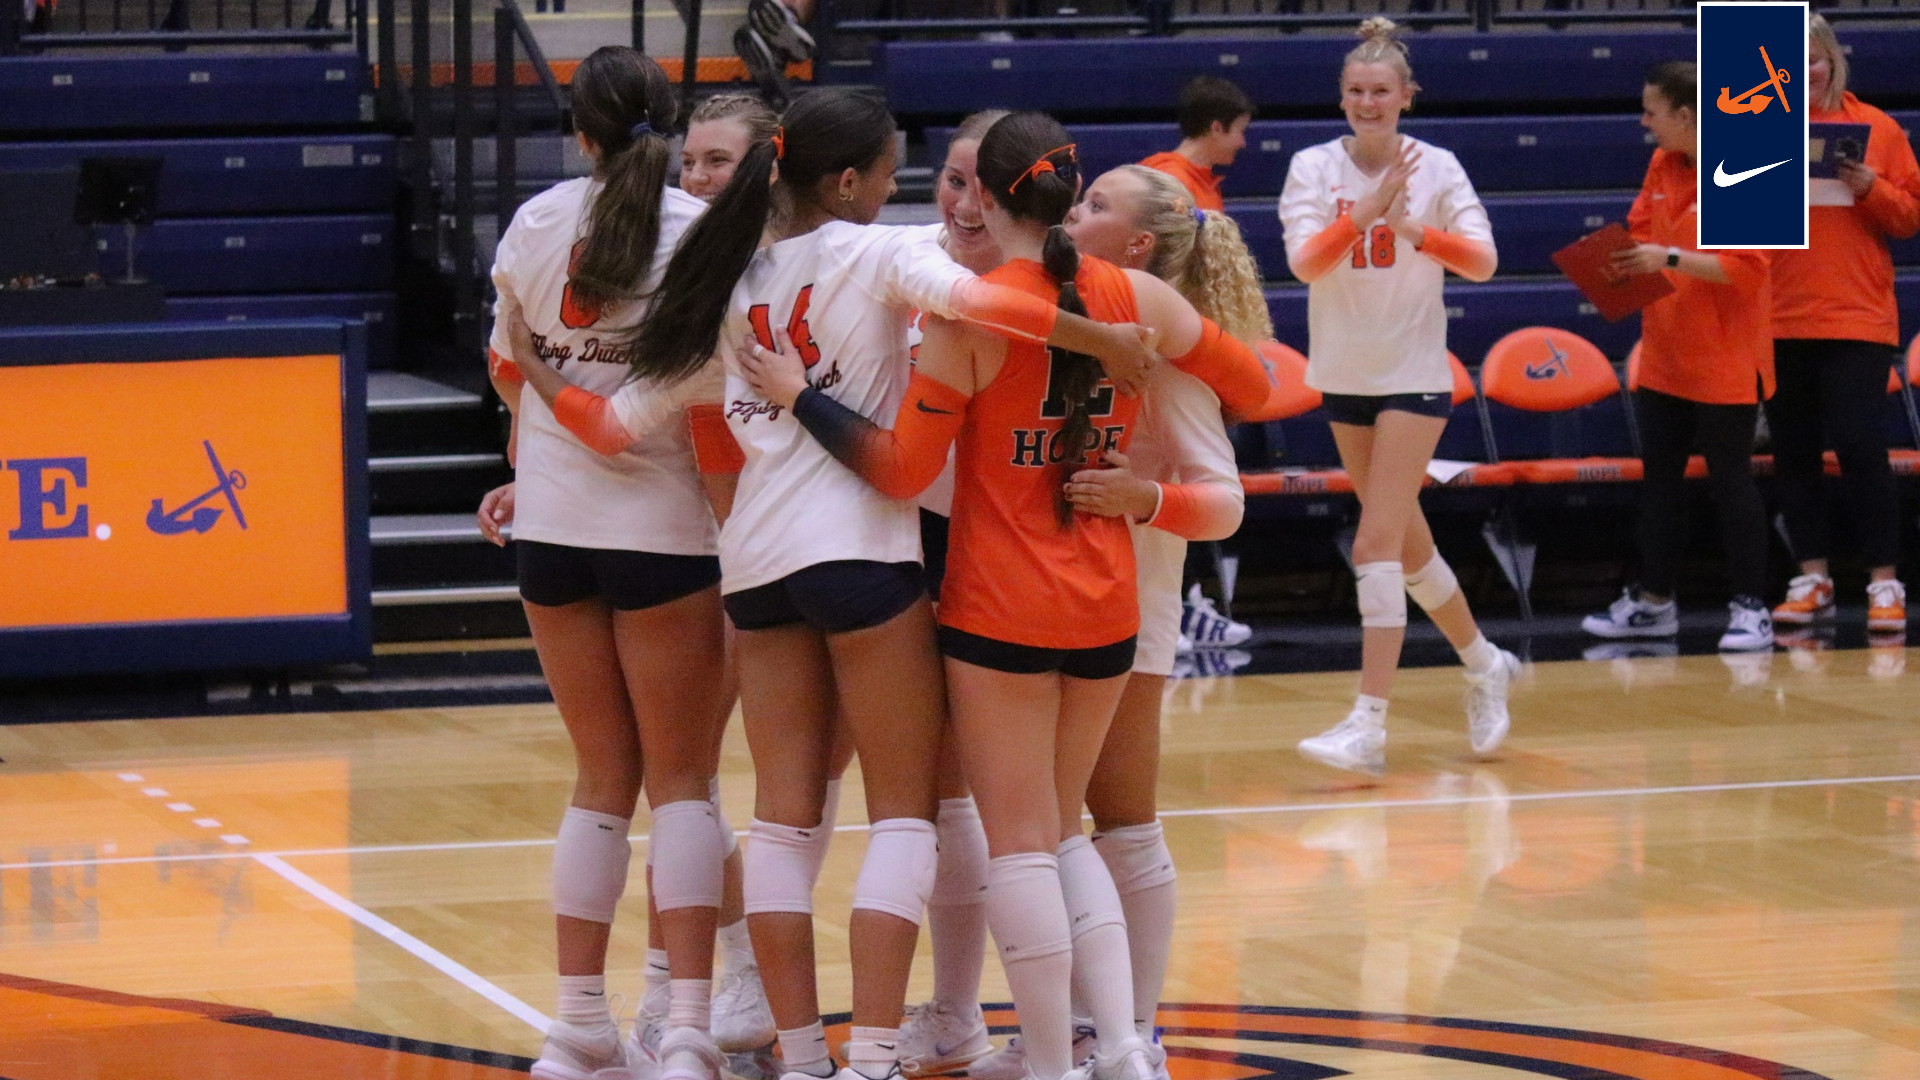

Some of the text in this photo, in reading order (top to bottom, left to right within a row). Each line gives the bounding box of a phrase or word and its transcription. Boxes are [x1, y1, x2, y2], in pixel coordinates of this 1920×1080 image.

[1351, 225, 1396, 269] 18
[1010, 424, 1126, 468] HOPE
[0, 456, 111, 541] E.
